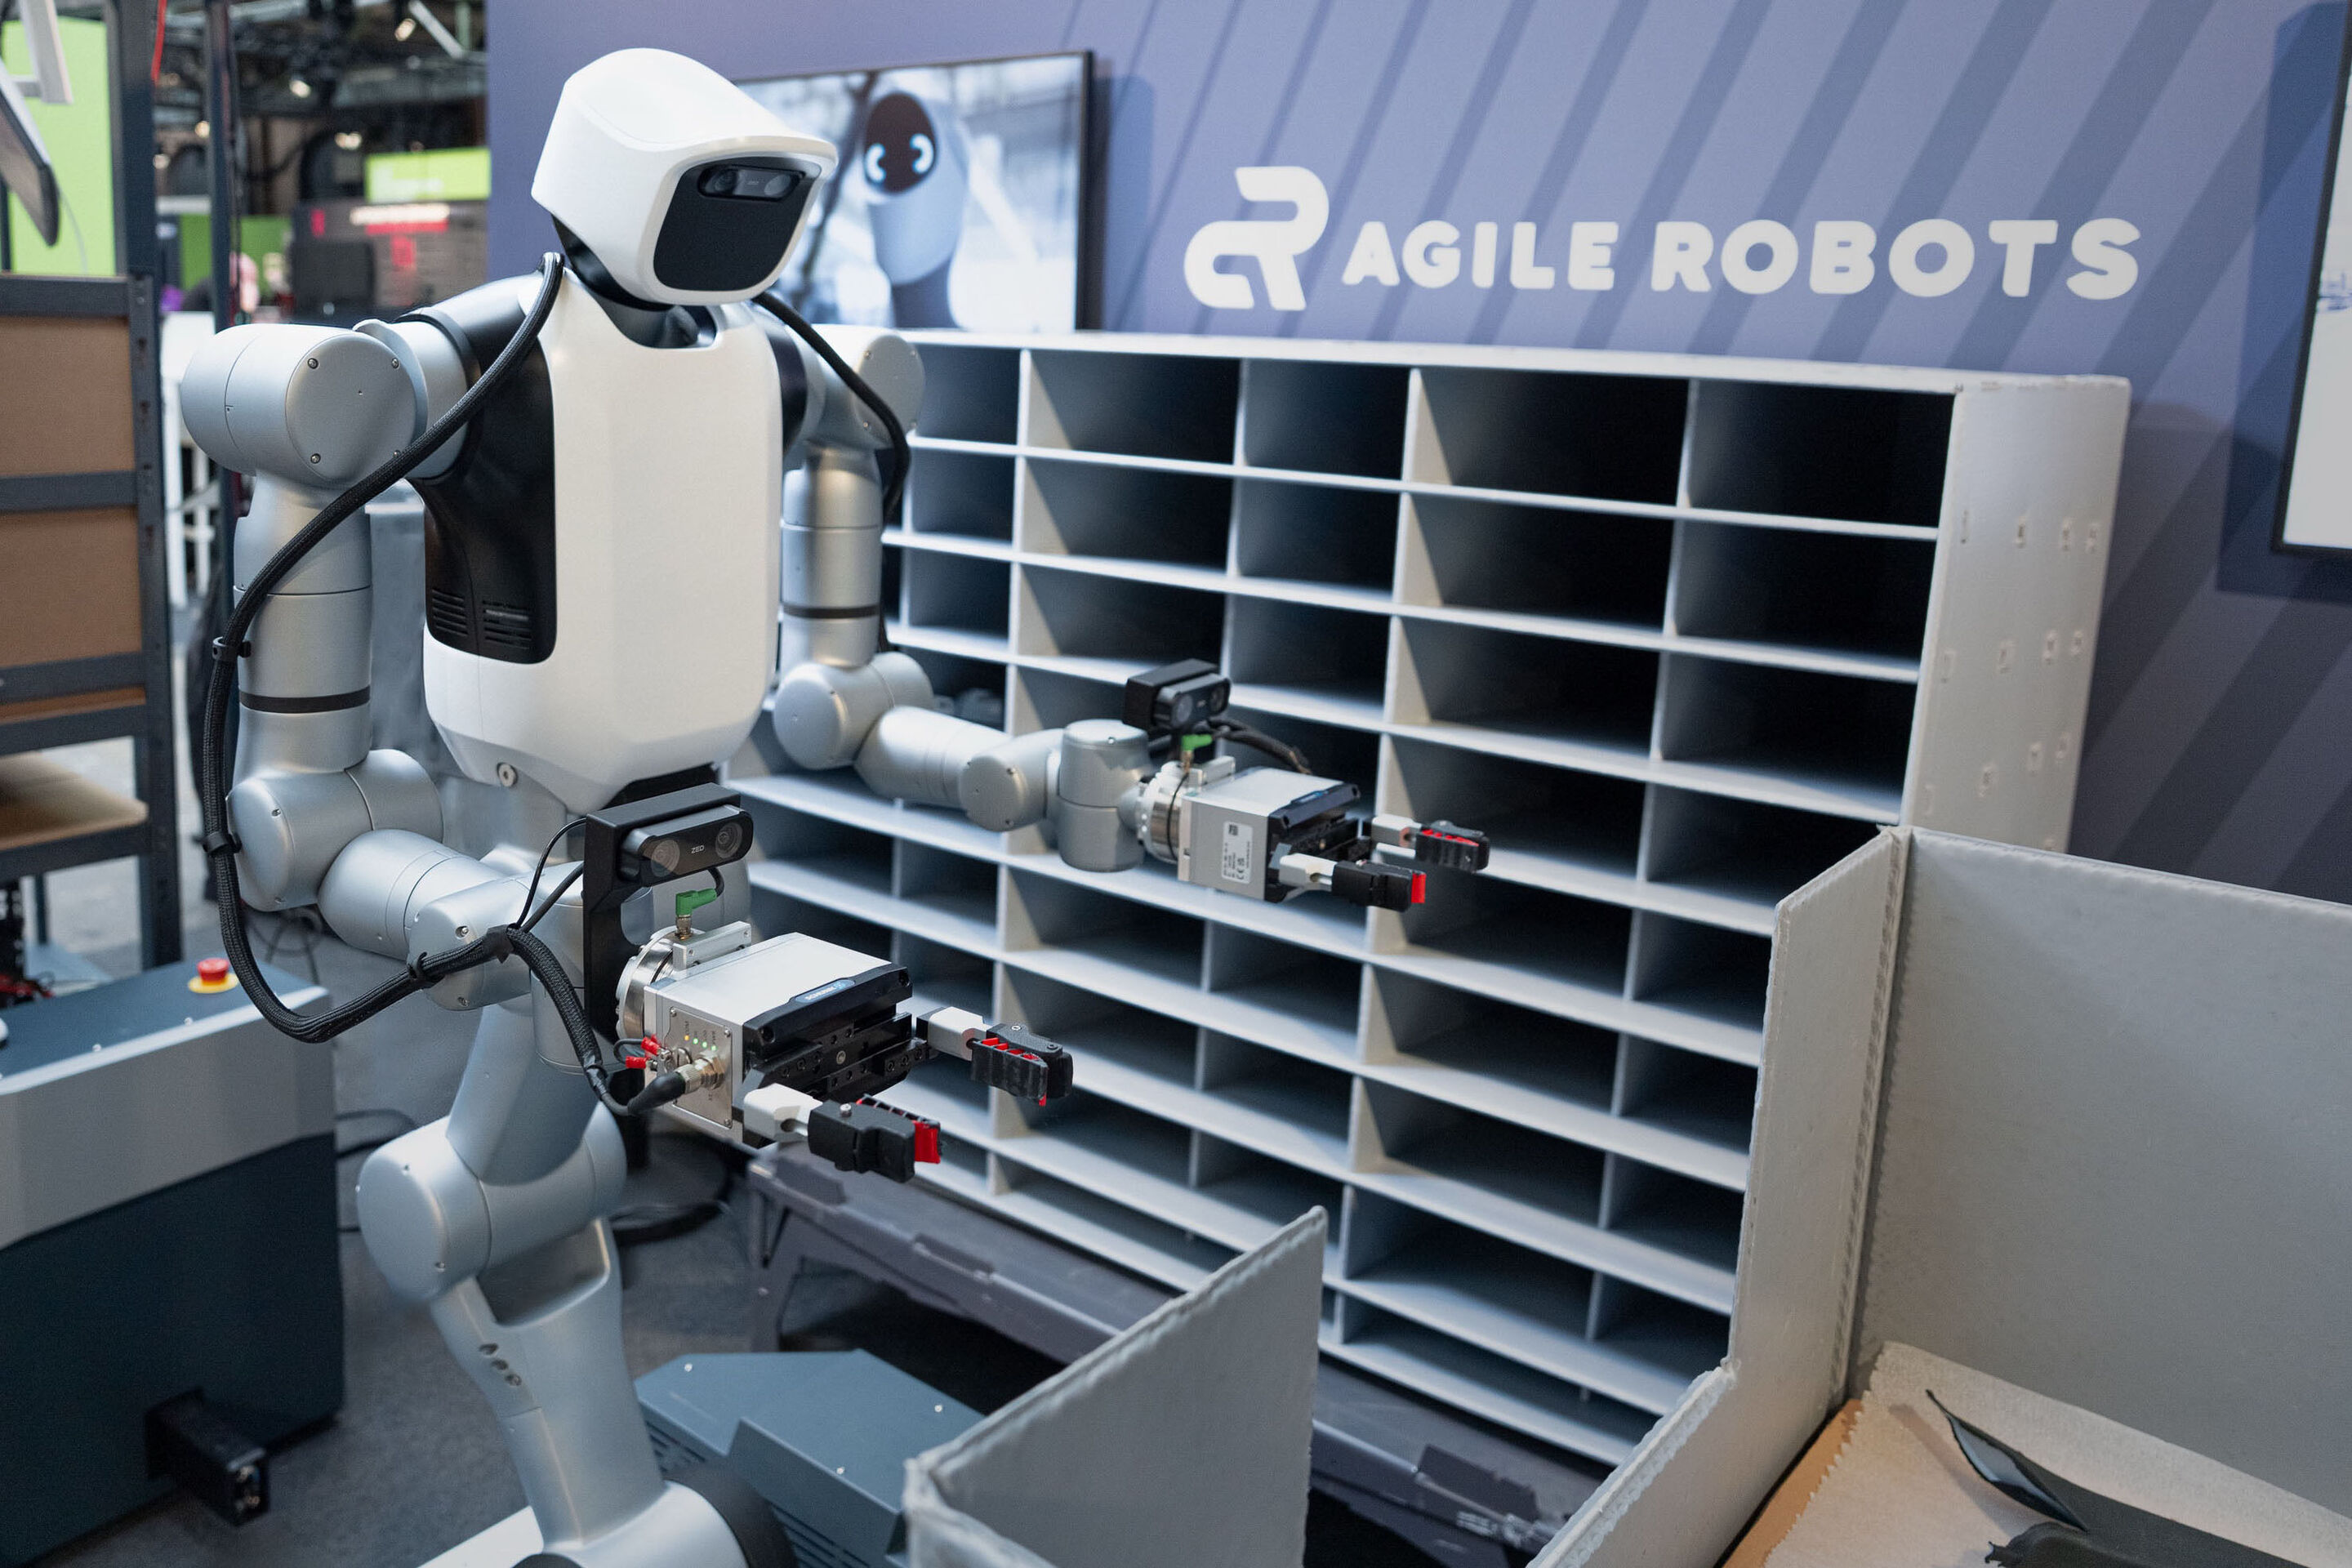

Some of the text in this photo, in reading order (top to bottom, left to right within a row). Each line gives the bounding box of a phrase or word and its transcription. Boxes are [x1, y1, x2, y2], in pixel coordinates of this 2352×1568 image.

[1342, 217, 2141, 300] AGILE ROBOTS
[691, 844, 705, 854] ZED
